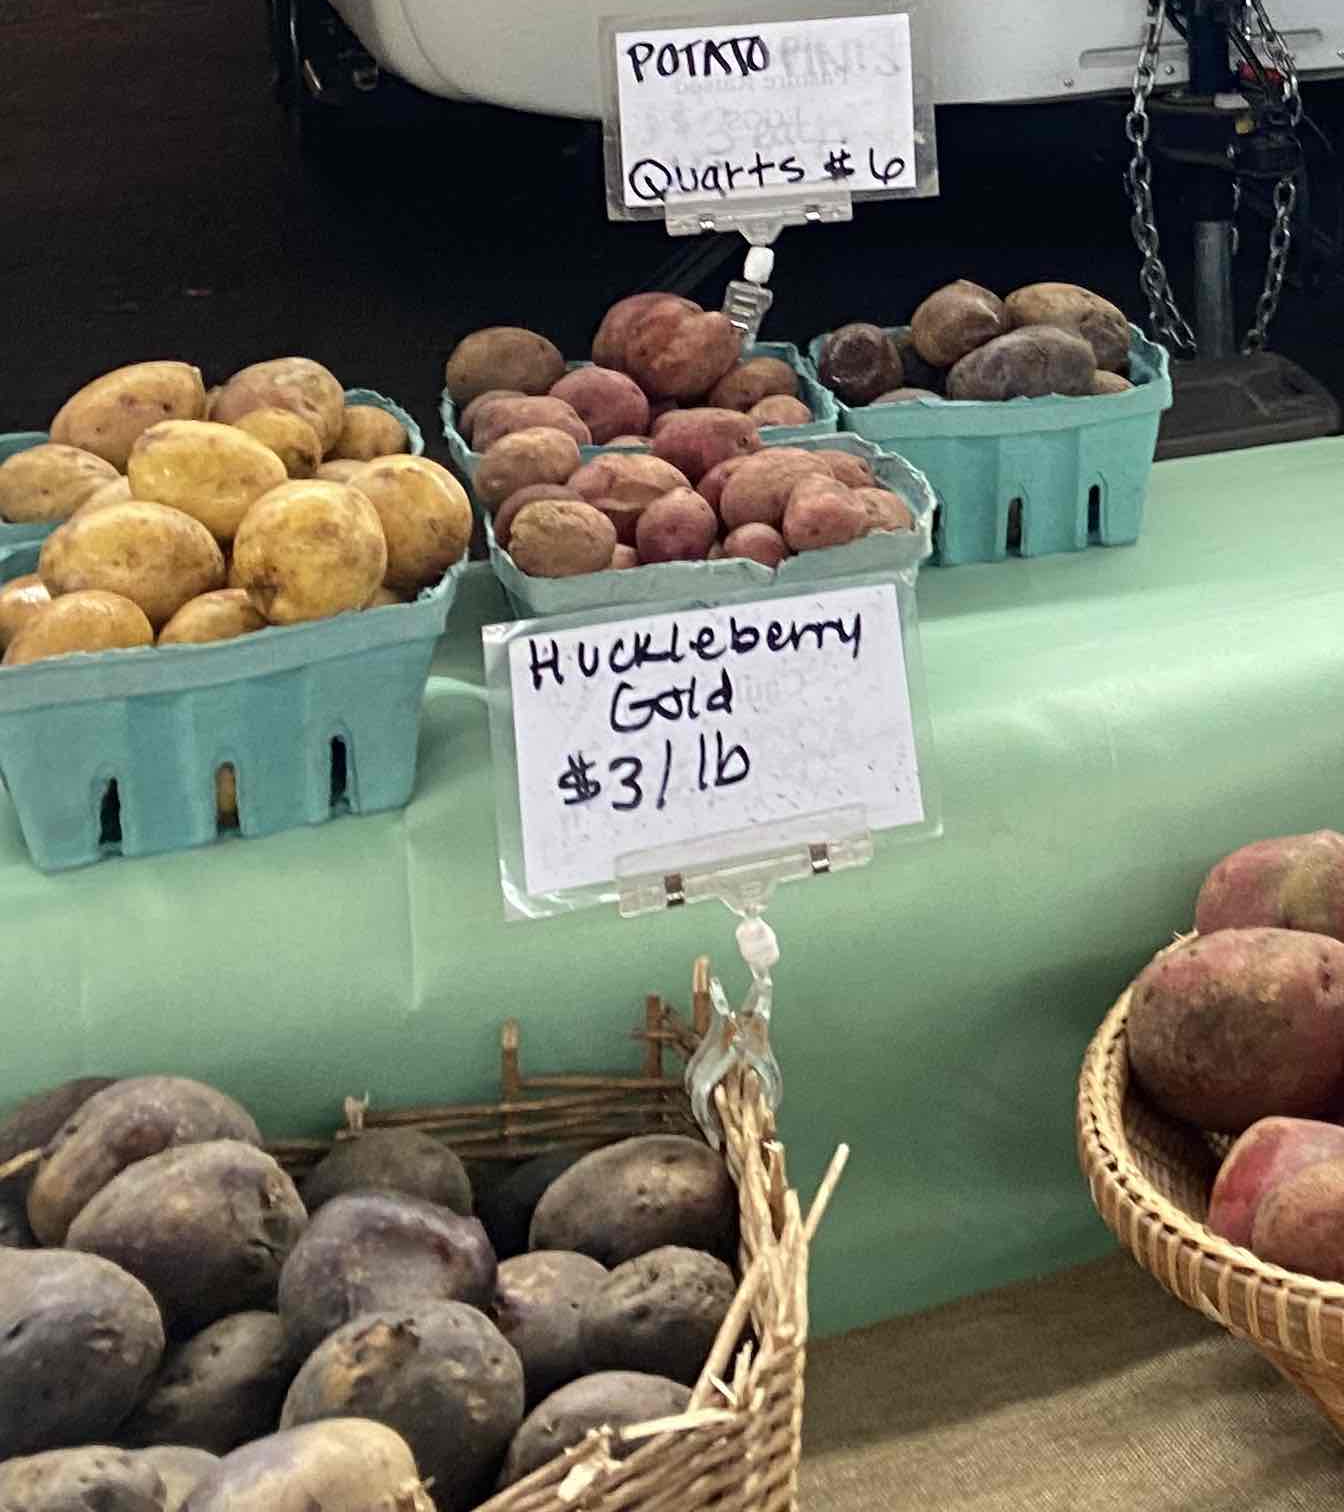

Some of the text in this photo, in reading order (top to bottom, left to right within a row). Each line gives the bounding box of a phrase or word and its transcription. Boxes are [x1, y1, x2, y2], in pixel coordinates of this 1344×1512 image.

[627, 34, 769, 82] POTATO
[629, 152, 805, 201] Quarts
[609, 666, 735, 734] Gold
